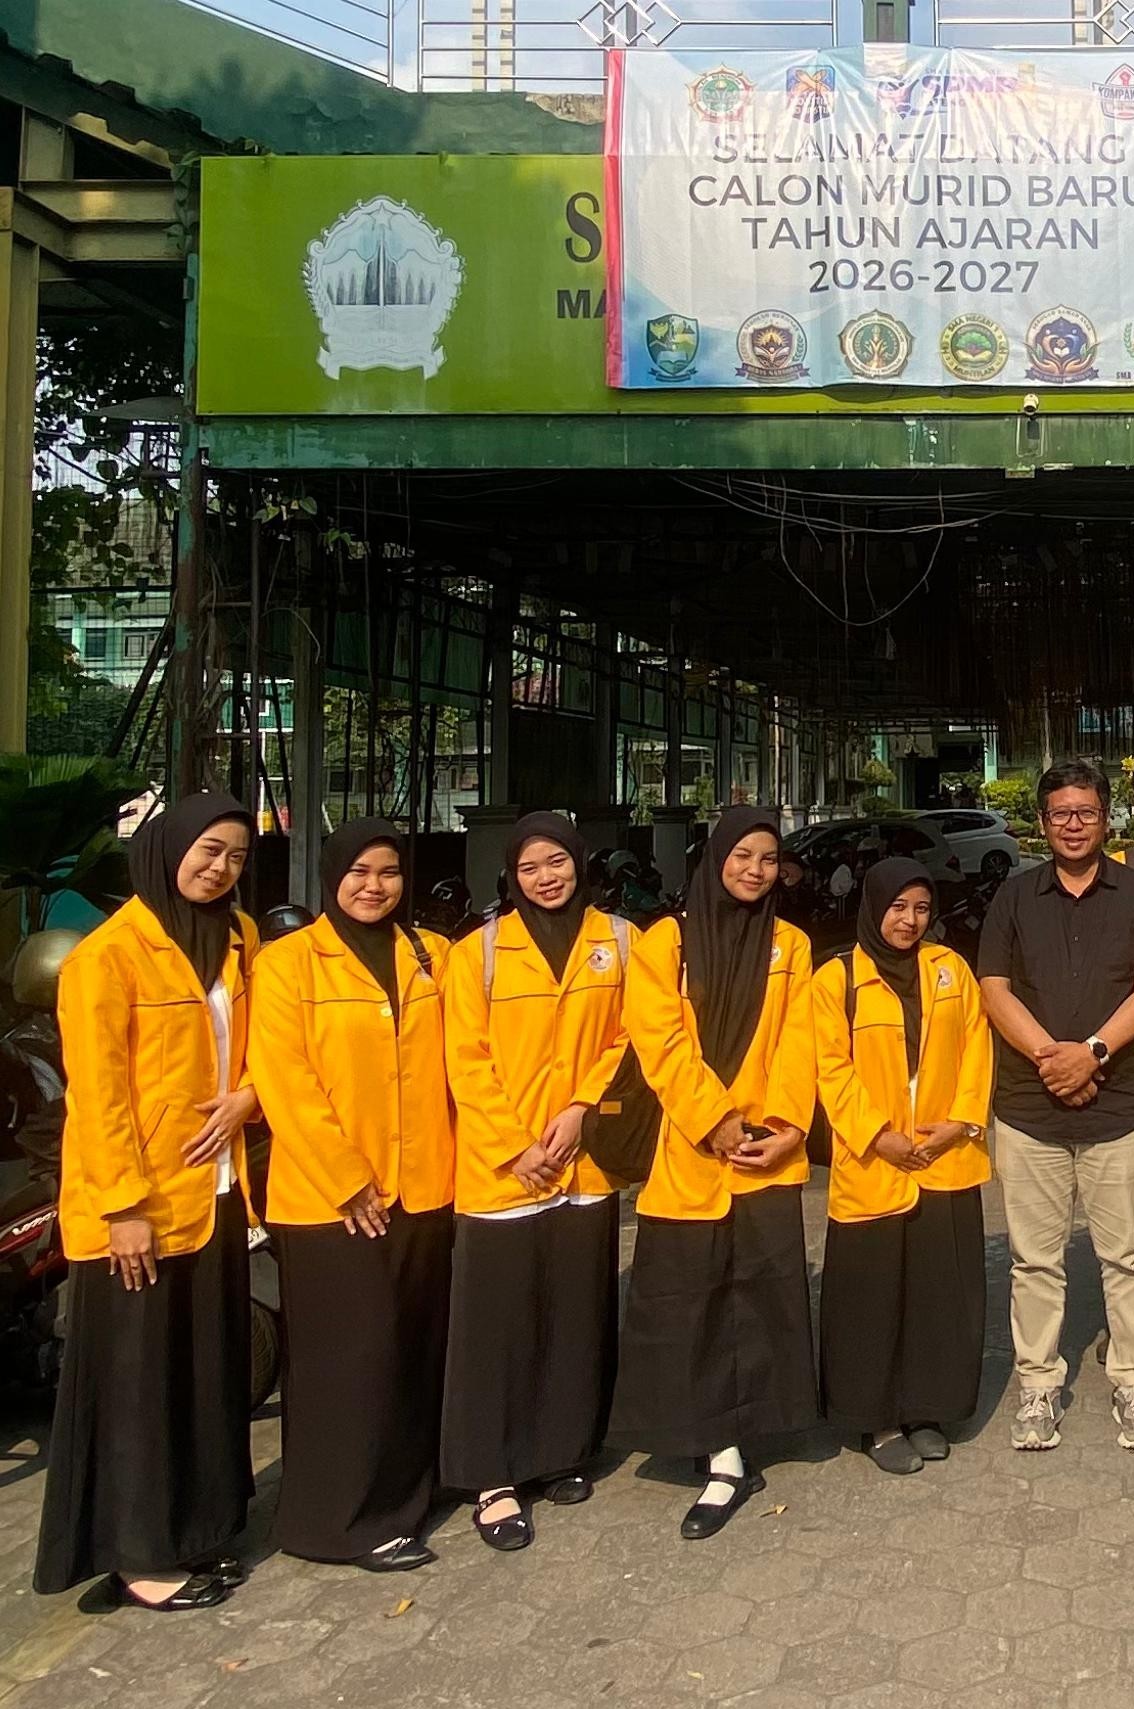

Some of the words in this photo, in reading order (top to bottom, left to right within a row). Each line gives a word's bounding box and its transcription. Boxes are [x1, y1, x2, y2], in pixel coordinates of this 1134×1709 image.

[689, 174, 843, 206] CALON
[861, 174, 1012, 206] MURID
[741, 216, 900, 250] TAHUN
[916, 217, 1099, 250] AJARAN
[808, 259, 1040, 294] 2026-2027
